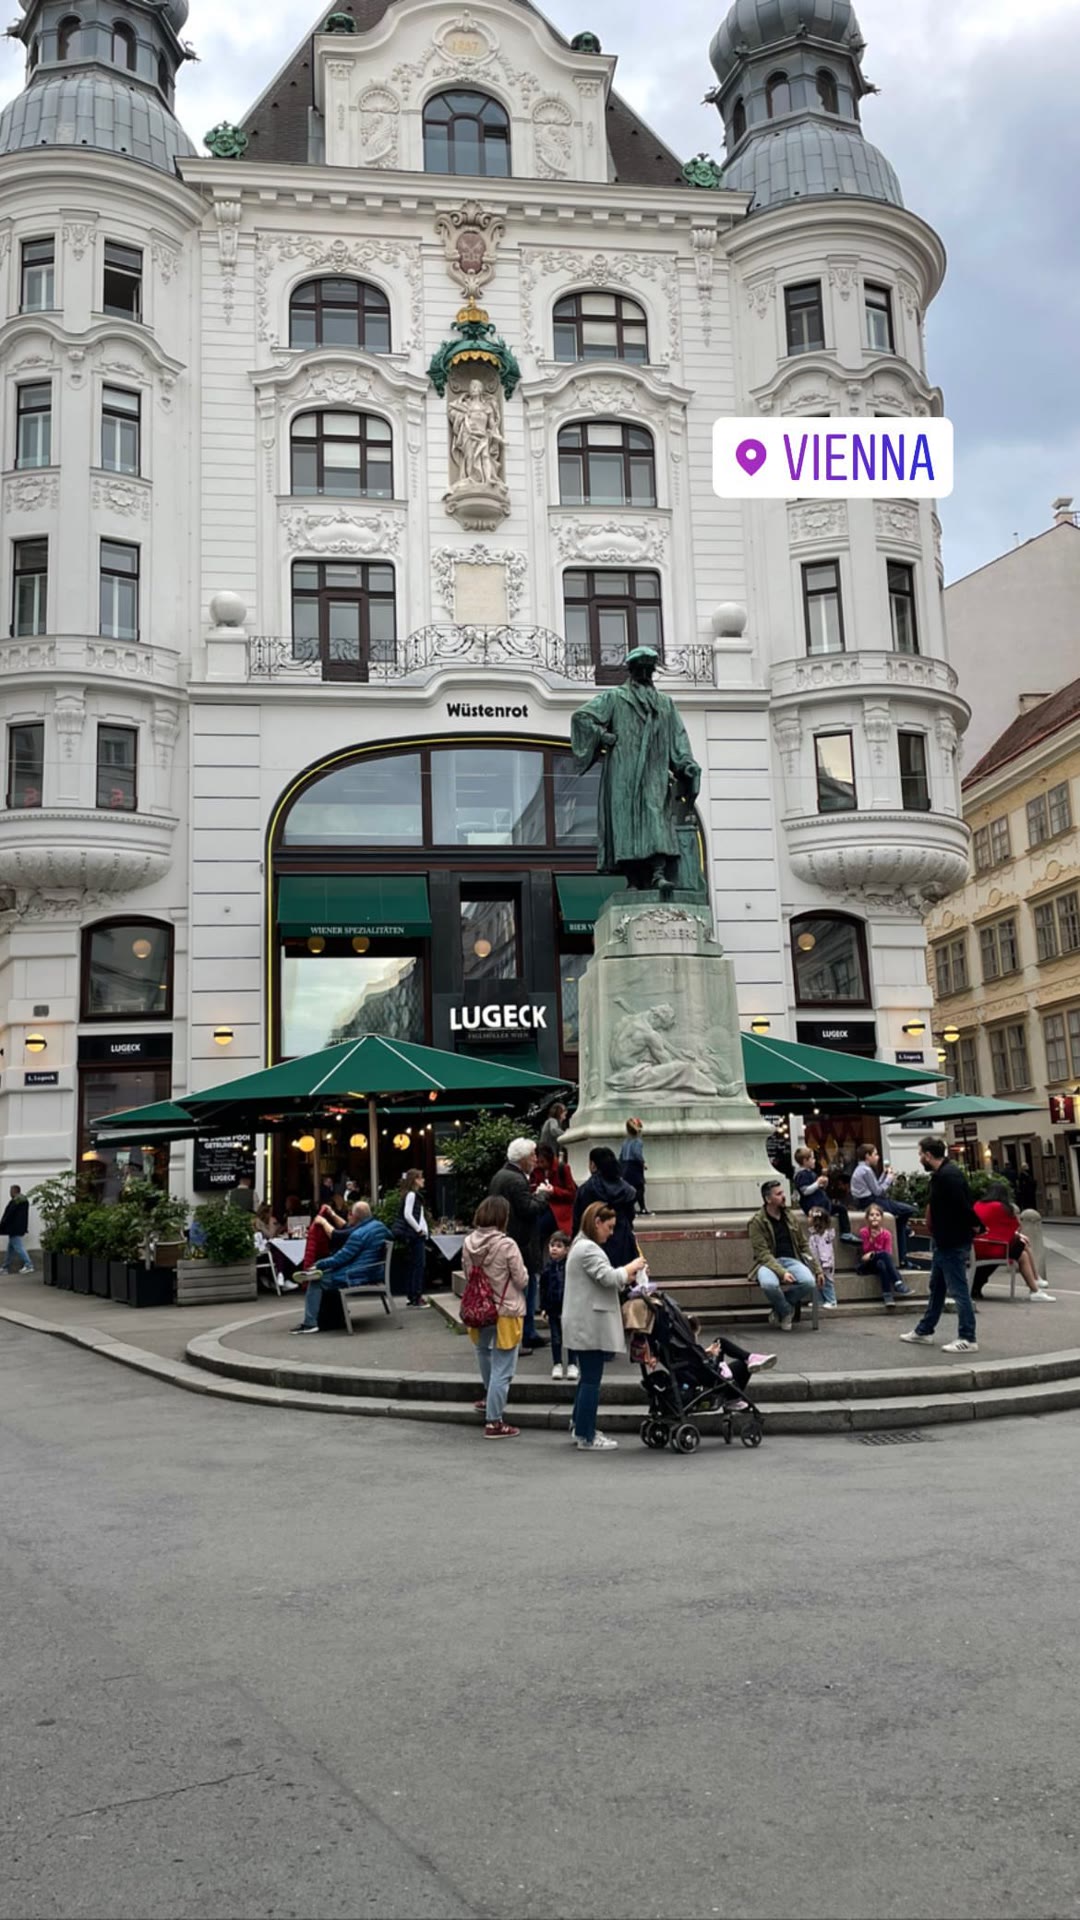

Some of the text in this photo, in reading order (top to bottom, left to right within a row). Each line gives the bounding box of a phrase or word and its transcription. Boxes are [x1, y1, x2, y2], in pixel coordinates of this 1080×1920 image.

[446, 702, 529, 718] Wüstenrot
[310, 925, 405, 935] WIENER SPEZIALITÄTEN
[569, 923, 587, 931] BIER
[634, 928, 698, 941] GUTENBERG
[449, 1004, 547, 1031] LUGECK
[822, 1030, 848, 1038] LUGECK
[110, 1044, 141, 1053] LUGECK
[210, 1174, 236, 1182] LUGECK
